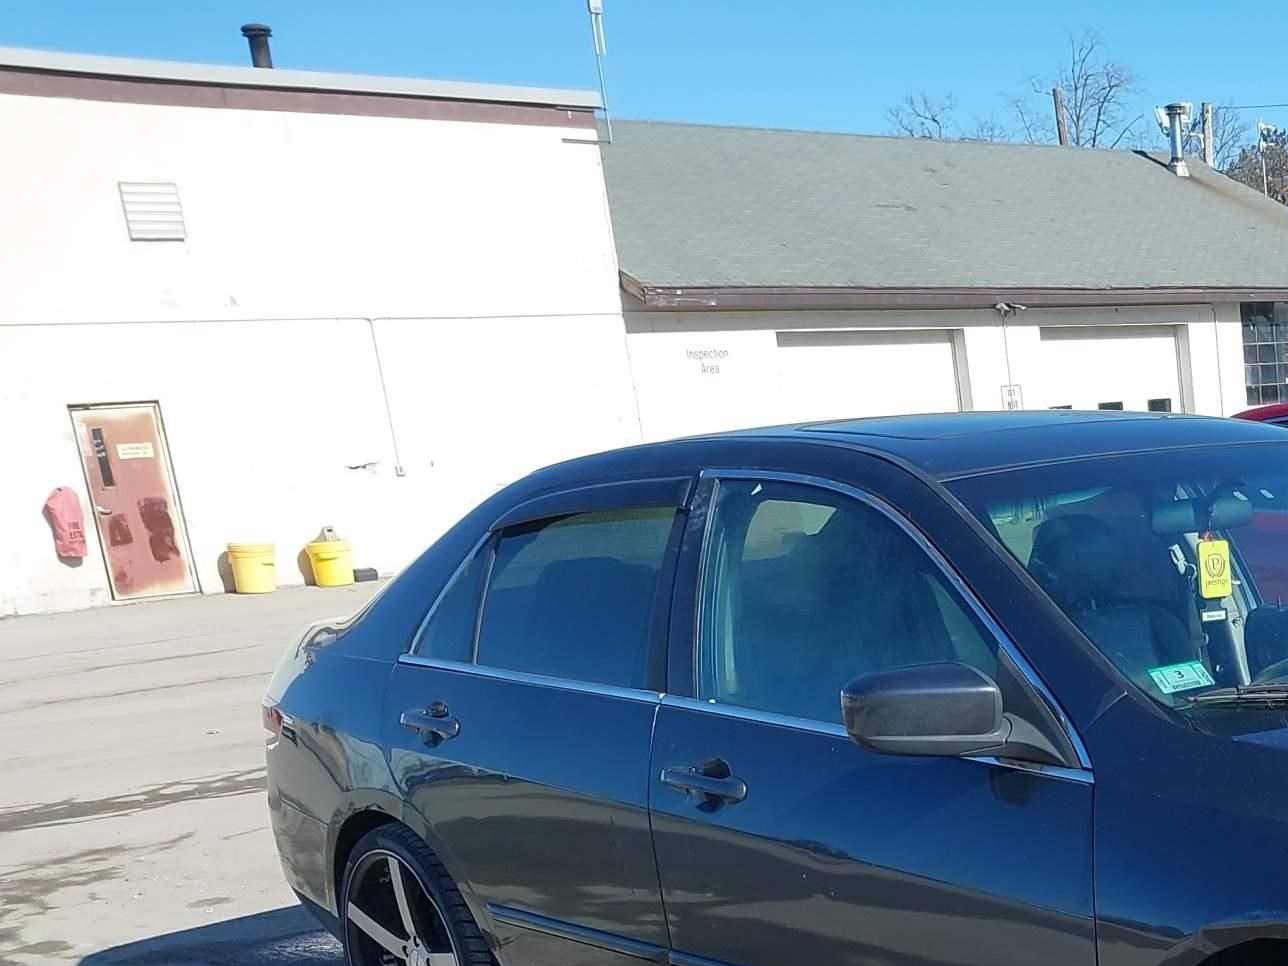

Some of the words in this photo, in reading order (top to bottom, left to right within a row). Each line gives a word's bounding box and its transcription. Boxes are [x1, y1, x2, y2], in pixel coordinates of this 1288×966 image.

[685, 348, 729, 362] Inspection
[701, 362, 720, 374] Area
[1173, 670, 1185, 679] 3
